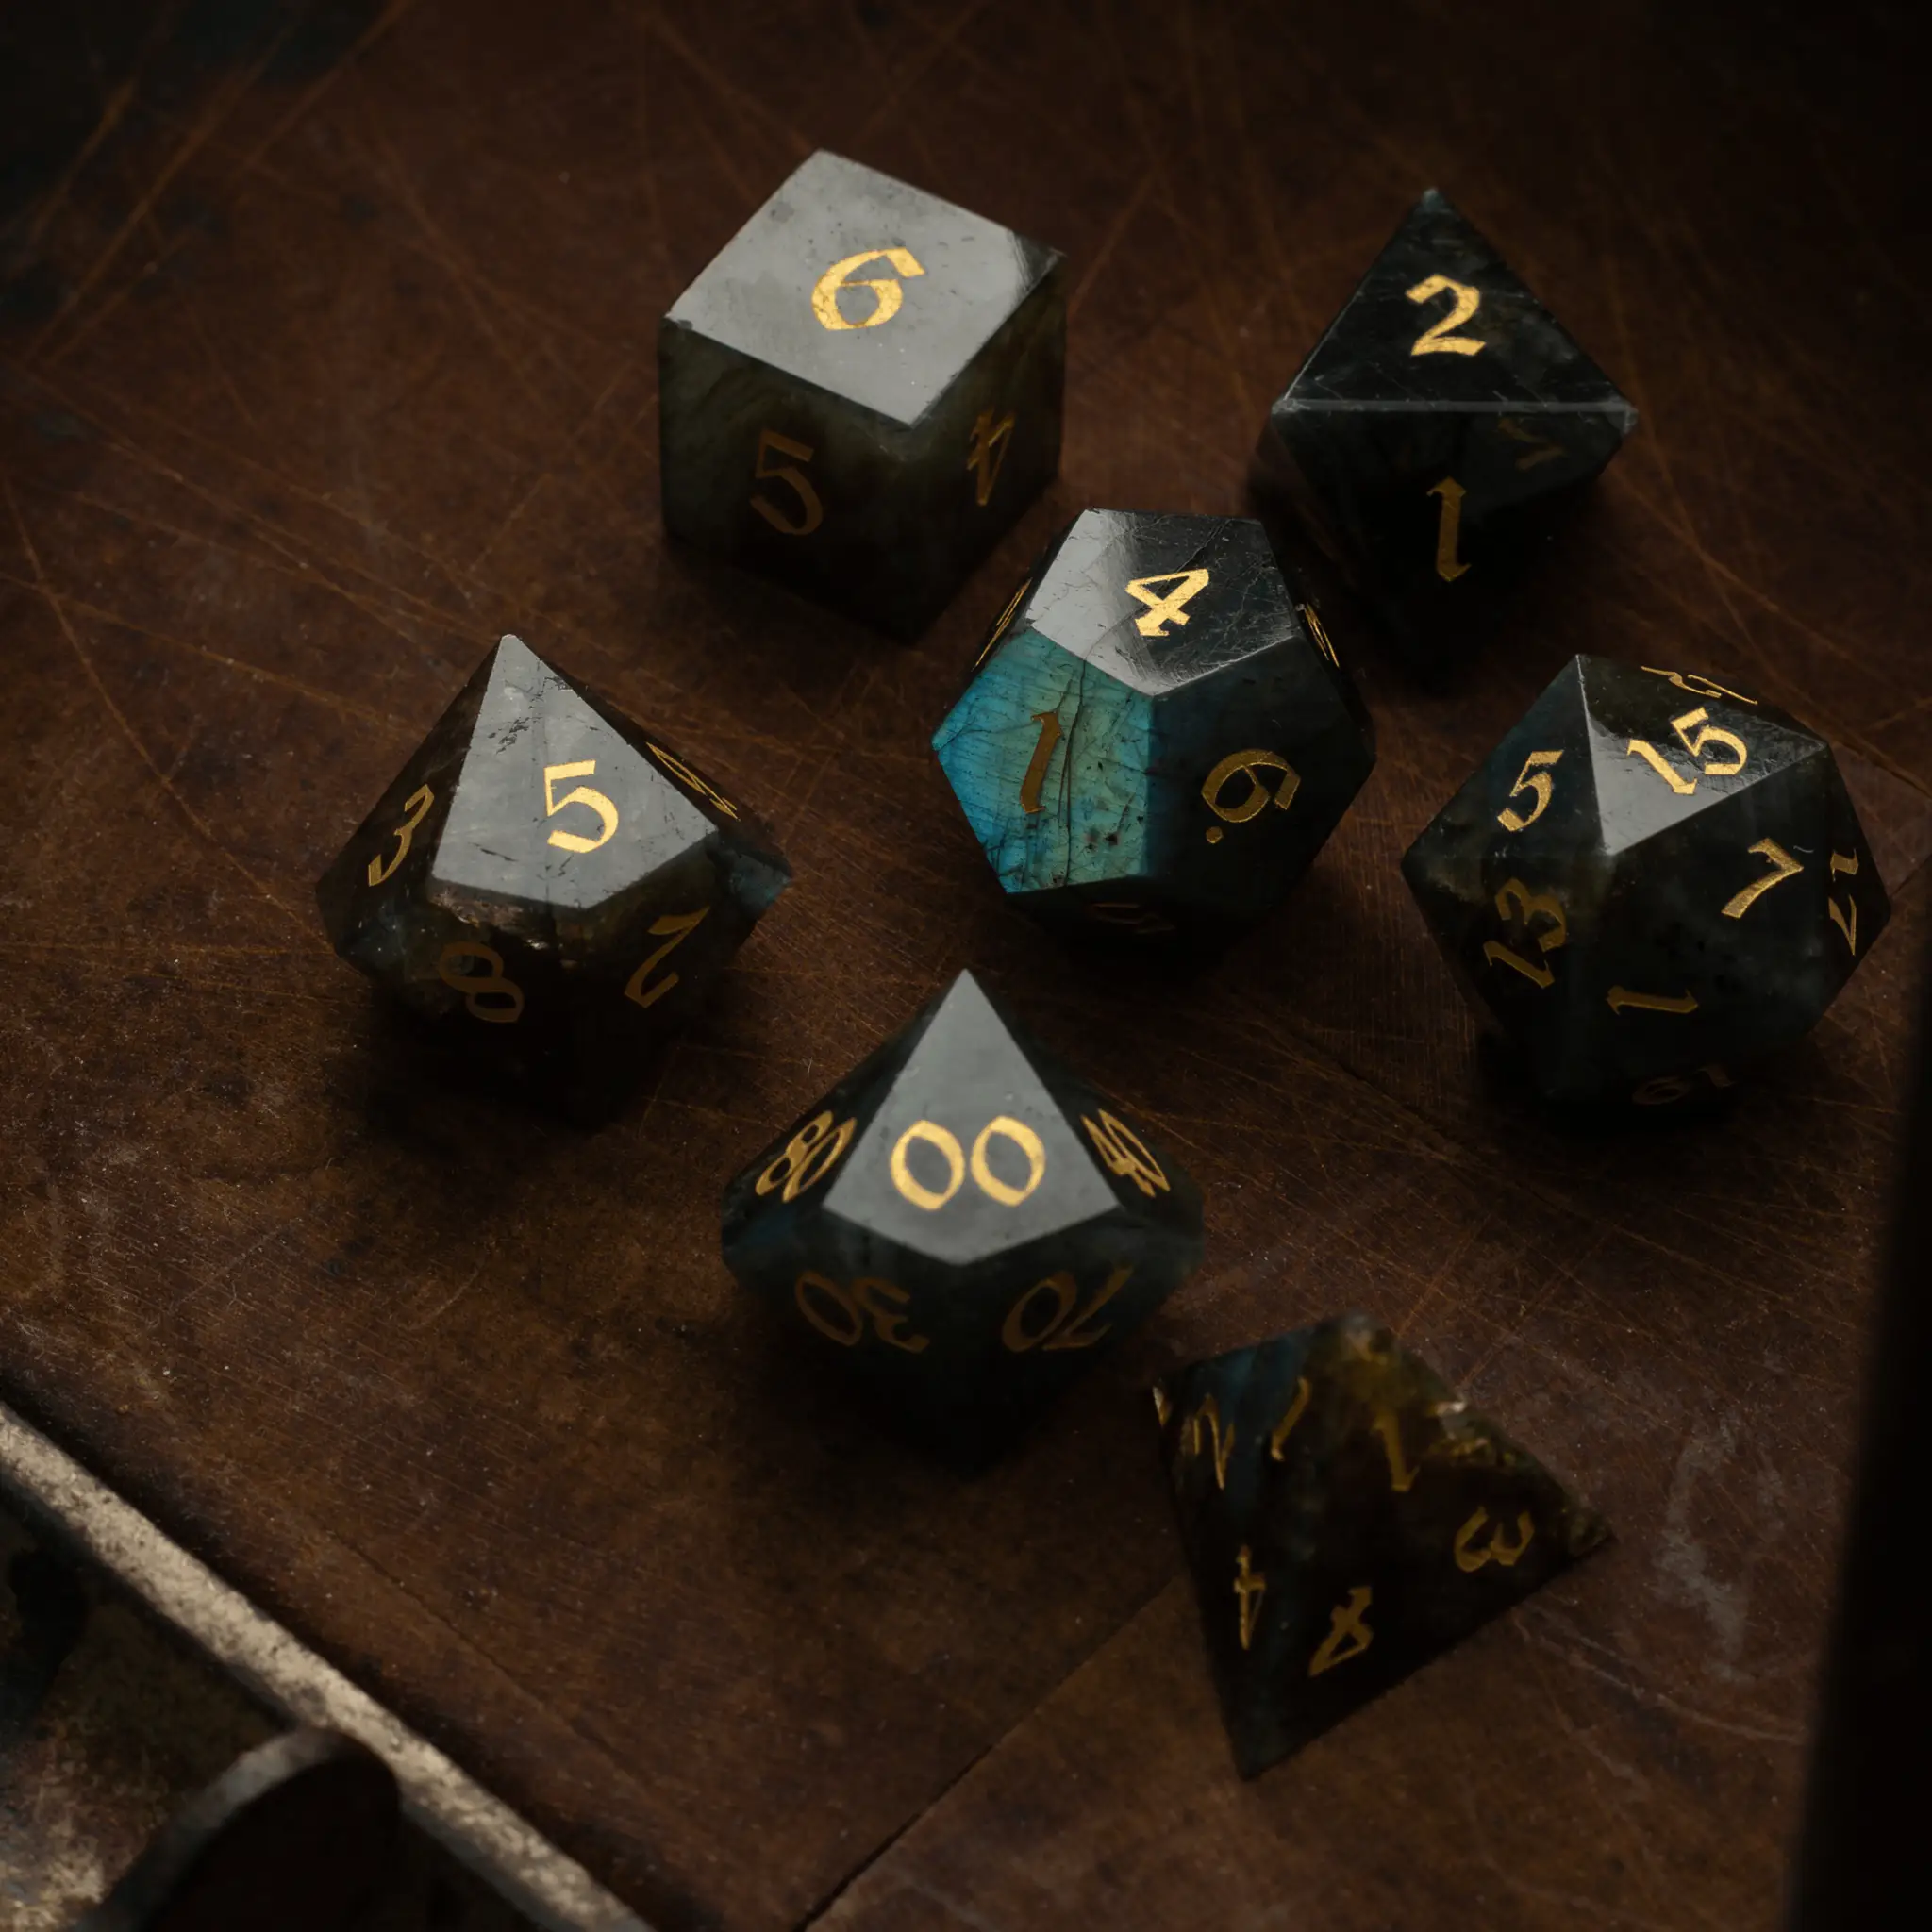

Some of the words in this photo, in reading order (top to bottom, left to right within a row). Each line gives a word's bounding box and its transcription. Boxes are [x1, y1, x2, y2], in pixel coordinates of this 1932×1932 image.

[811, 247, 925, 331] 6
[1405, 274, 1486, 357] 2
[749, 428, 824, 536] 5
[966, 405, 1015, 508] 4
[1426, 475, 1472, 582] 1
[1125, 568, 1209, 637] 4
[1020, 711, 1062, 814] 1
[1497, 749, 1565, 832] 5
[1625, 706, 1748, 796] 15
[367, 783, 435, 887] 3
[543, 759, 619, 853] 5
[1720, 837, 1804, 920] 7
[624, 905, 711, 1008] 2
[1482, 876, 1567, 990] 13
[438, 940, 525, 1024] 8
[1605, 984, 1699, 1015] 1
[755, 1109, 858, 1204] 80
[890, 1115, 1046, 1210] 00
[1080, 1108, 1172, 1198] 40
[794, 1270, 931, 1354] 30
[1001, 1263, 1134, 1354] 70
[1369, 1406, 1421, 1493] 1
[1453, 1506, 1536, 1574] 3
[1232, 1543, 1267, 1651] 4
[1307, 1586, 1375, 1680] 4
